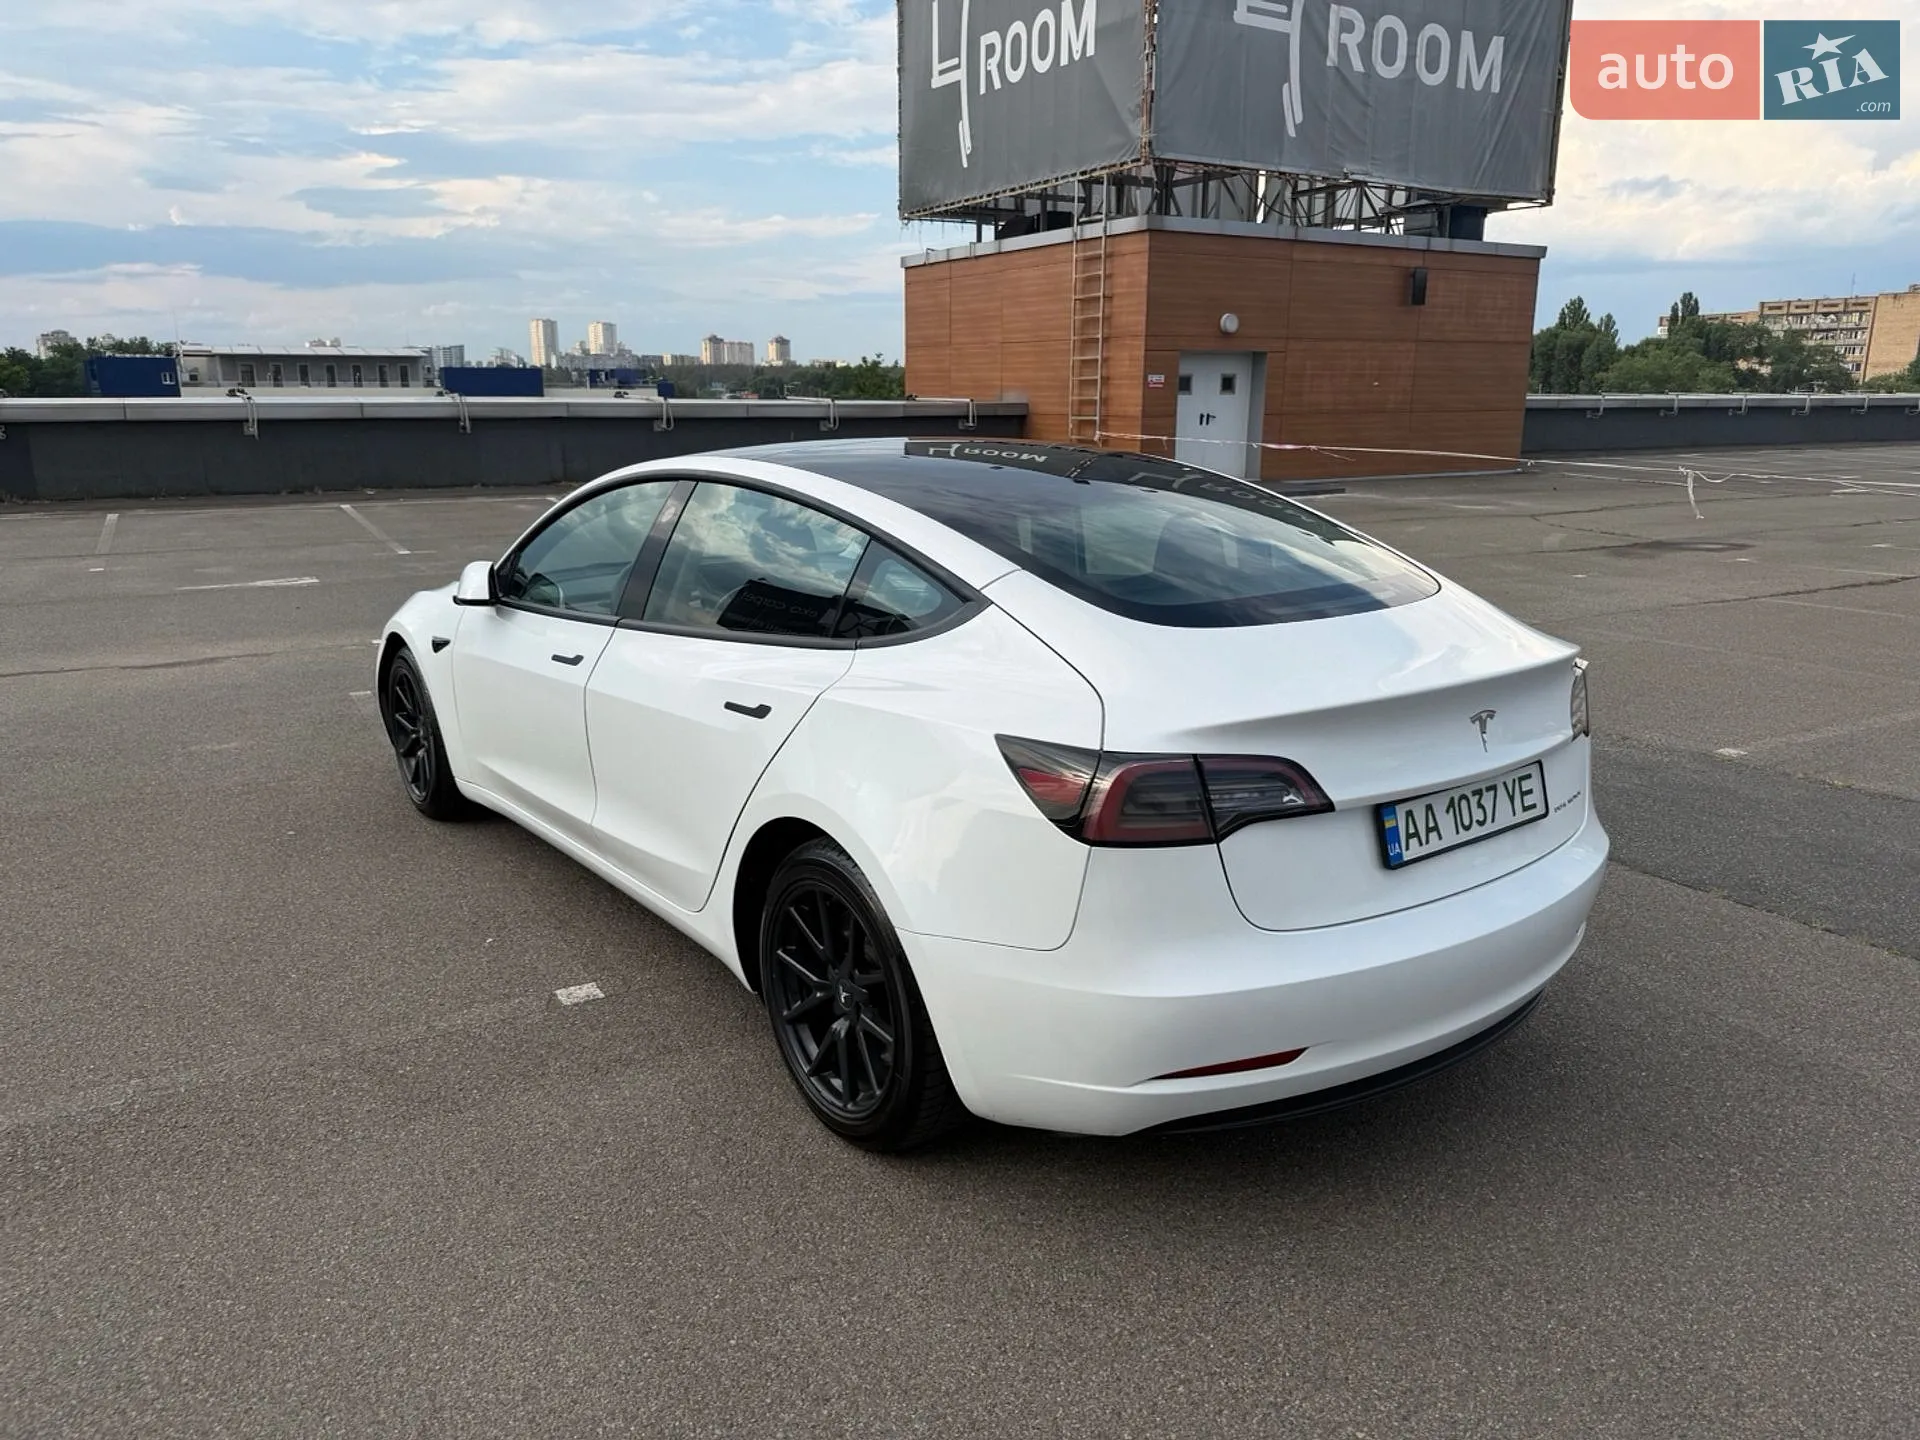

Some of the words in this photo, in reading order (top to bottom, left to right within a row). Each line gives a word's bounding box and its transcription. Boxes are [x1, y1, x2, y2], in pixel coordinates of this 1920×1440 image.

[1326, 3, 1505, 94] ROOM
[1387, 842, 1400, 856] UA
[1405, 803, 1443, 851] AA
[1445, 784, 1498, 835] 1037
[1502, 773, 1537, 817] YE
